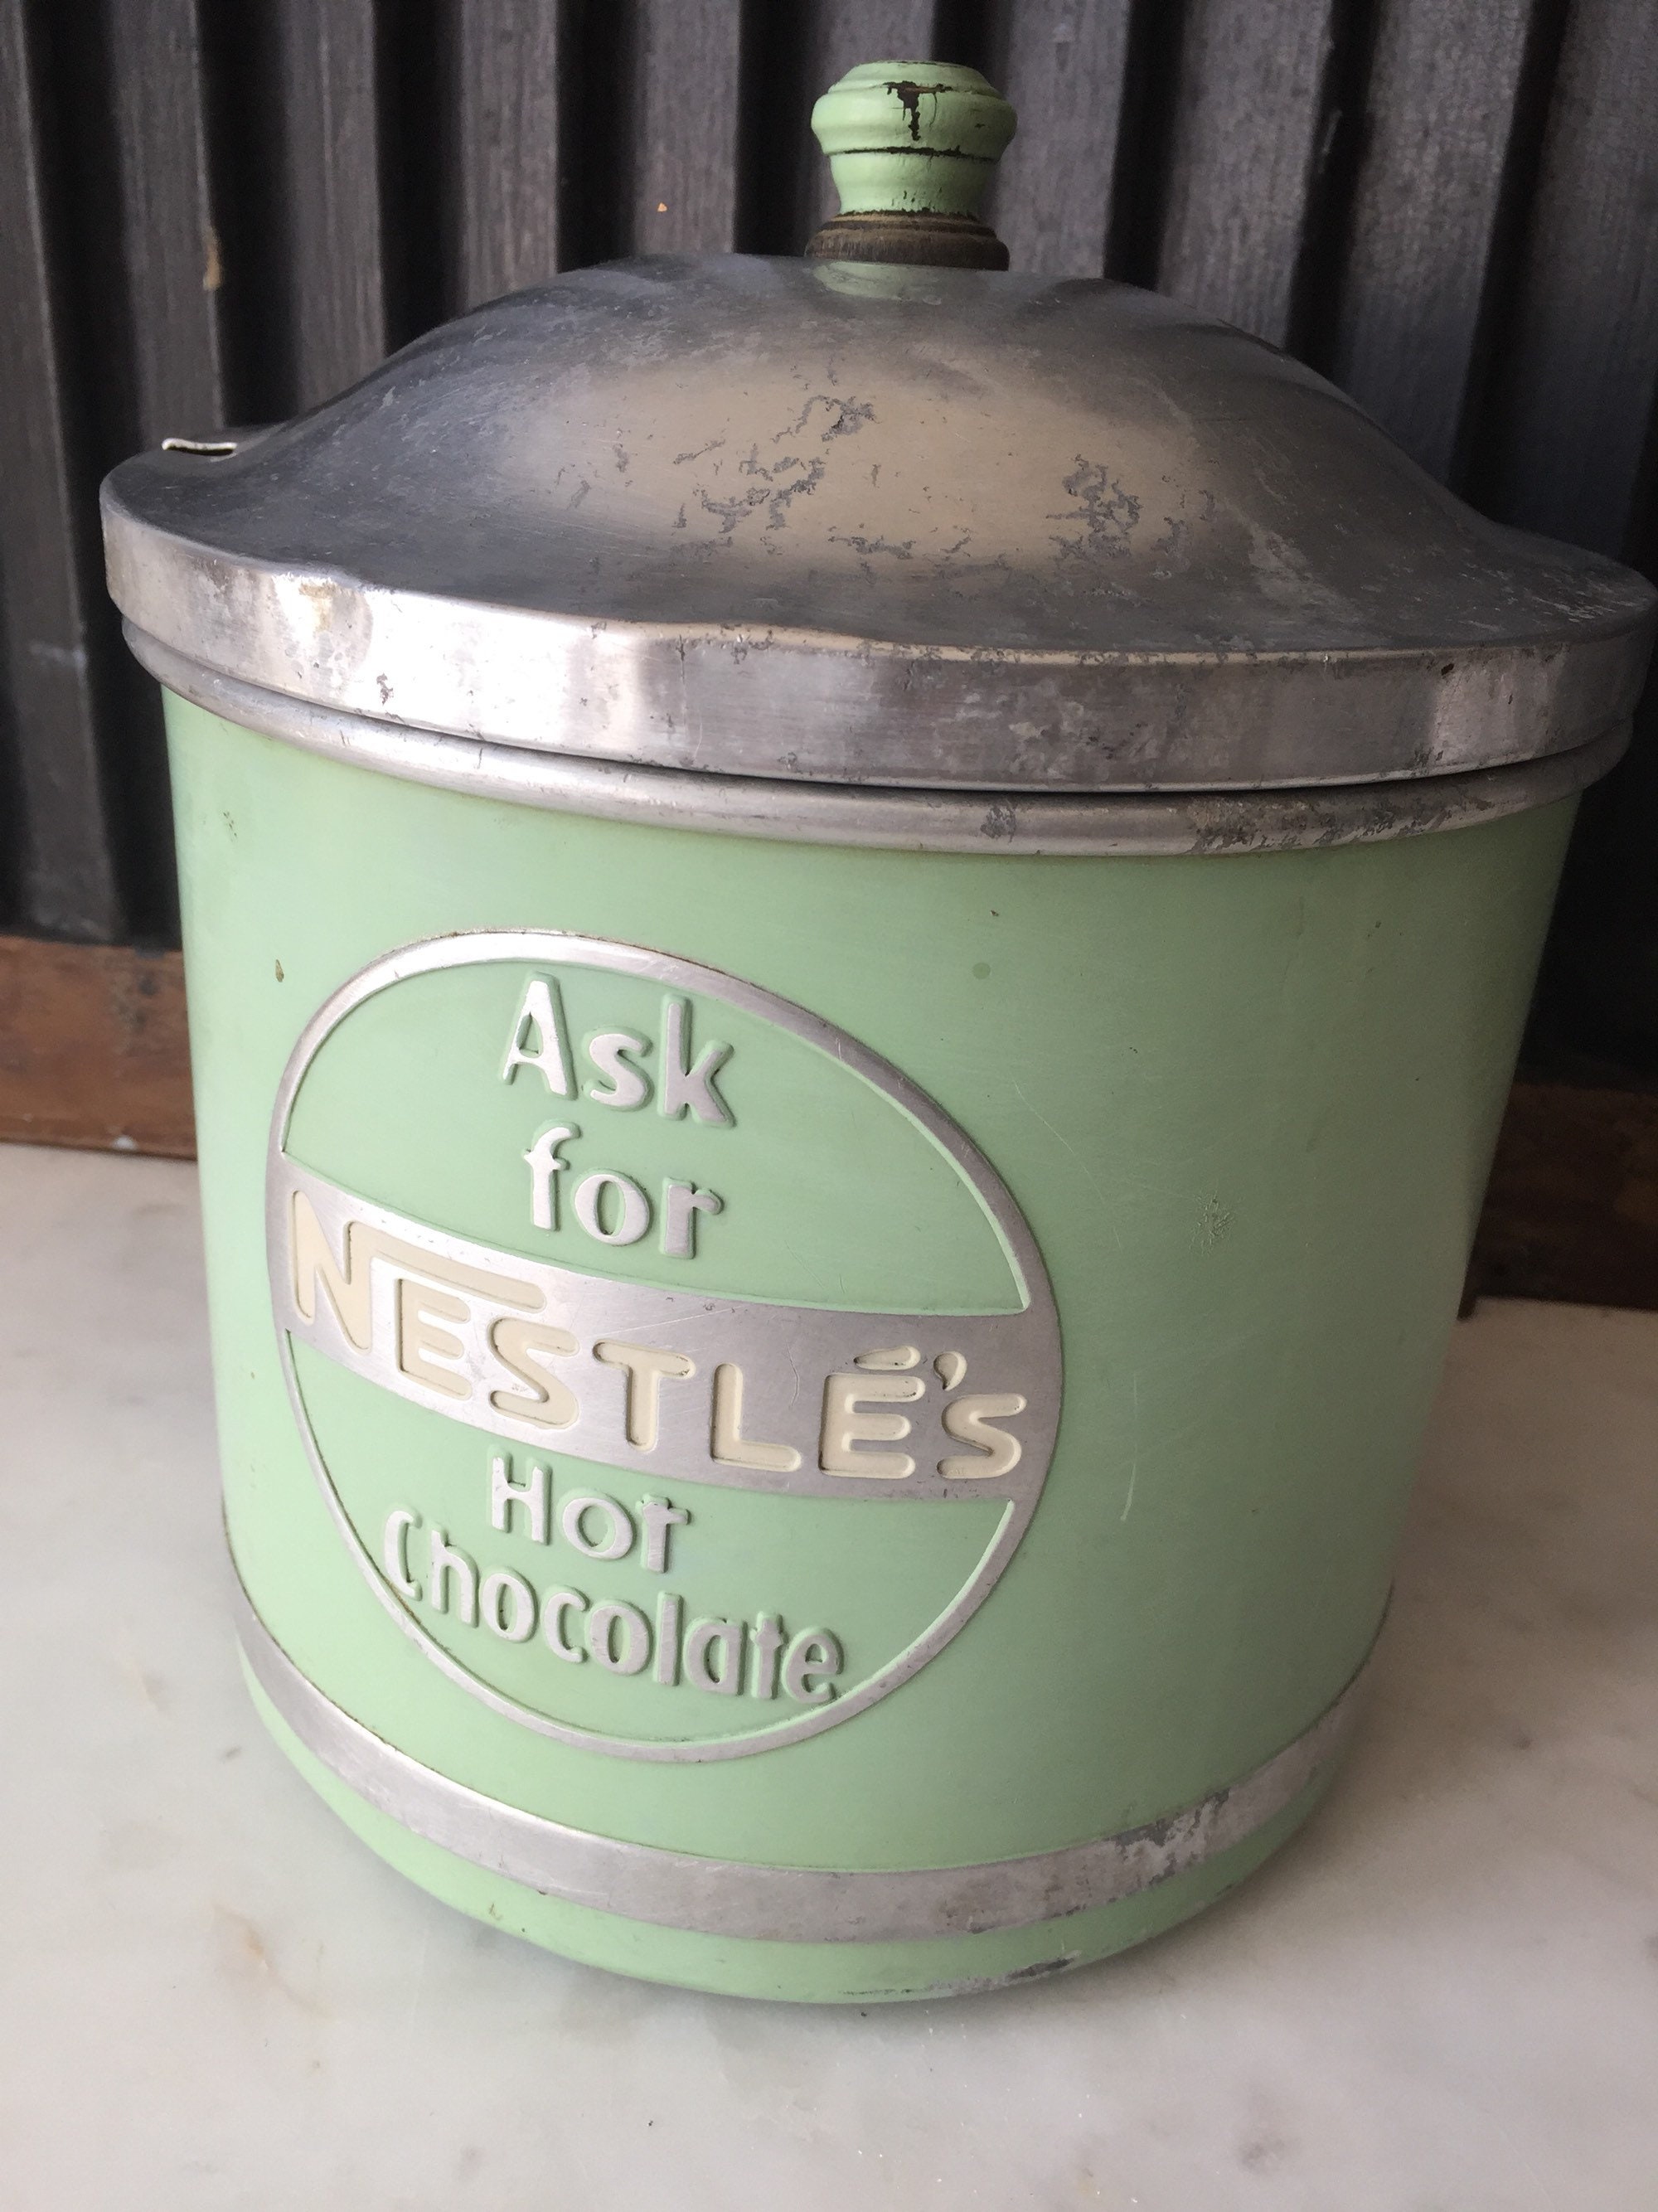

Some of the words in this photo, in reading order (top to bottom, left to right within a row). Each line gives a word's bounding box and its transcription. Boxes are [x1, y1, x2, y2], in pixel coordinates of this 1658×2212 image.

[500, 973, 734, 1127] Ask
[524, 1120, 723, 1258] for
[487, 1447, 691, 1573] Hot
[382, 1503, 843, 1705] Chocolate
